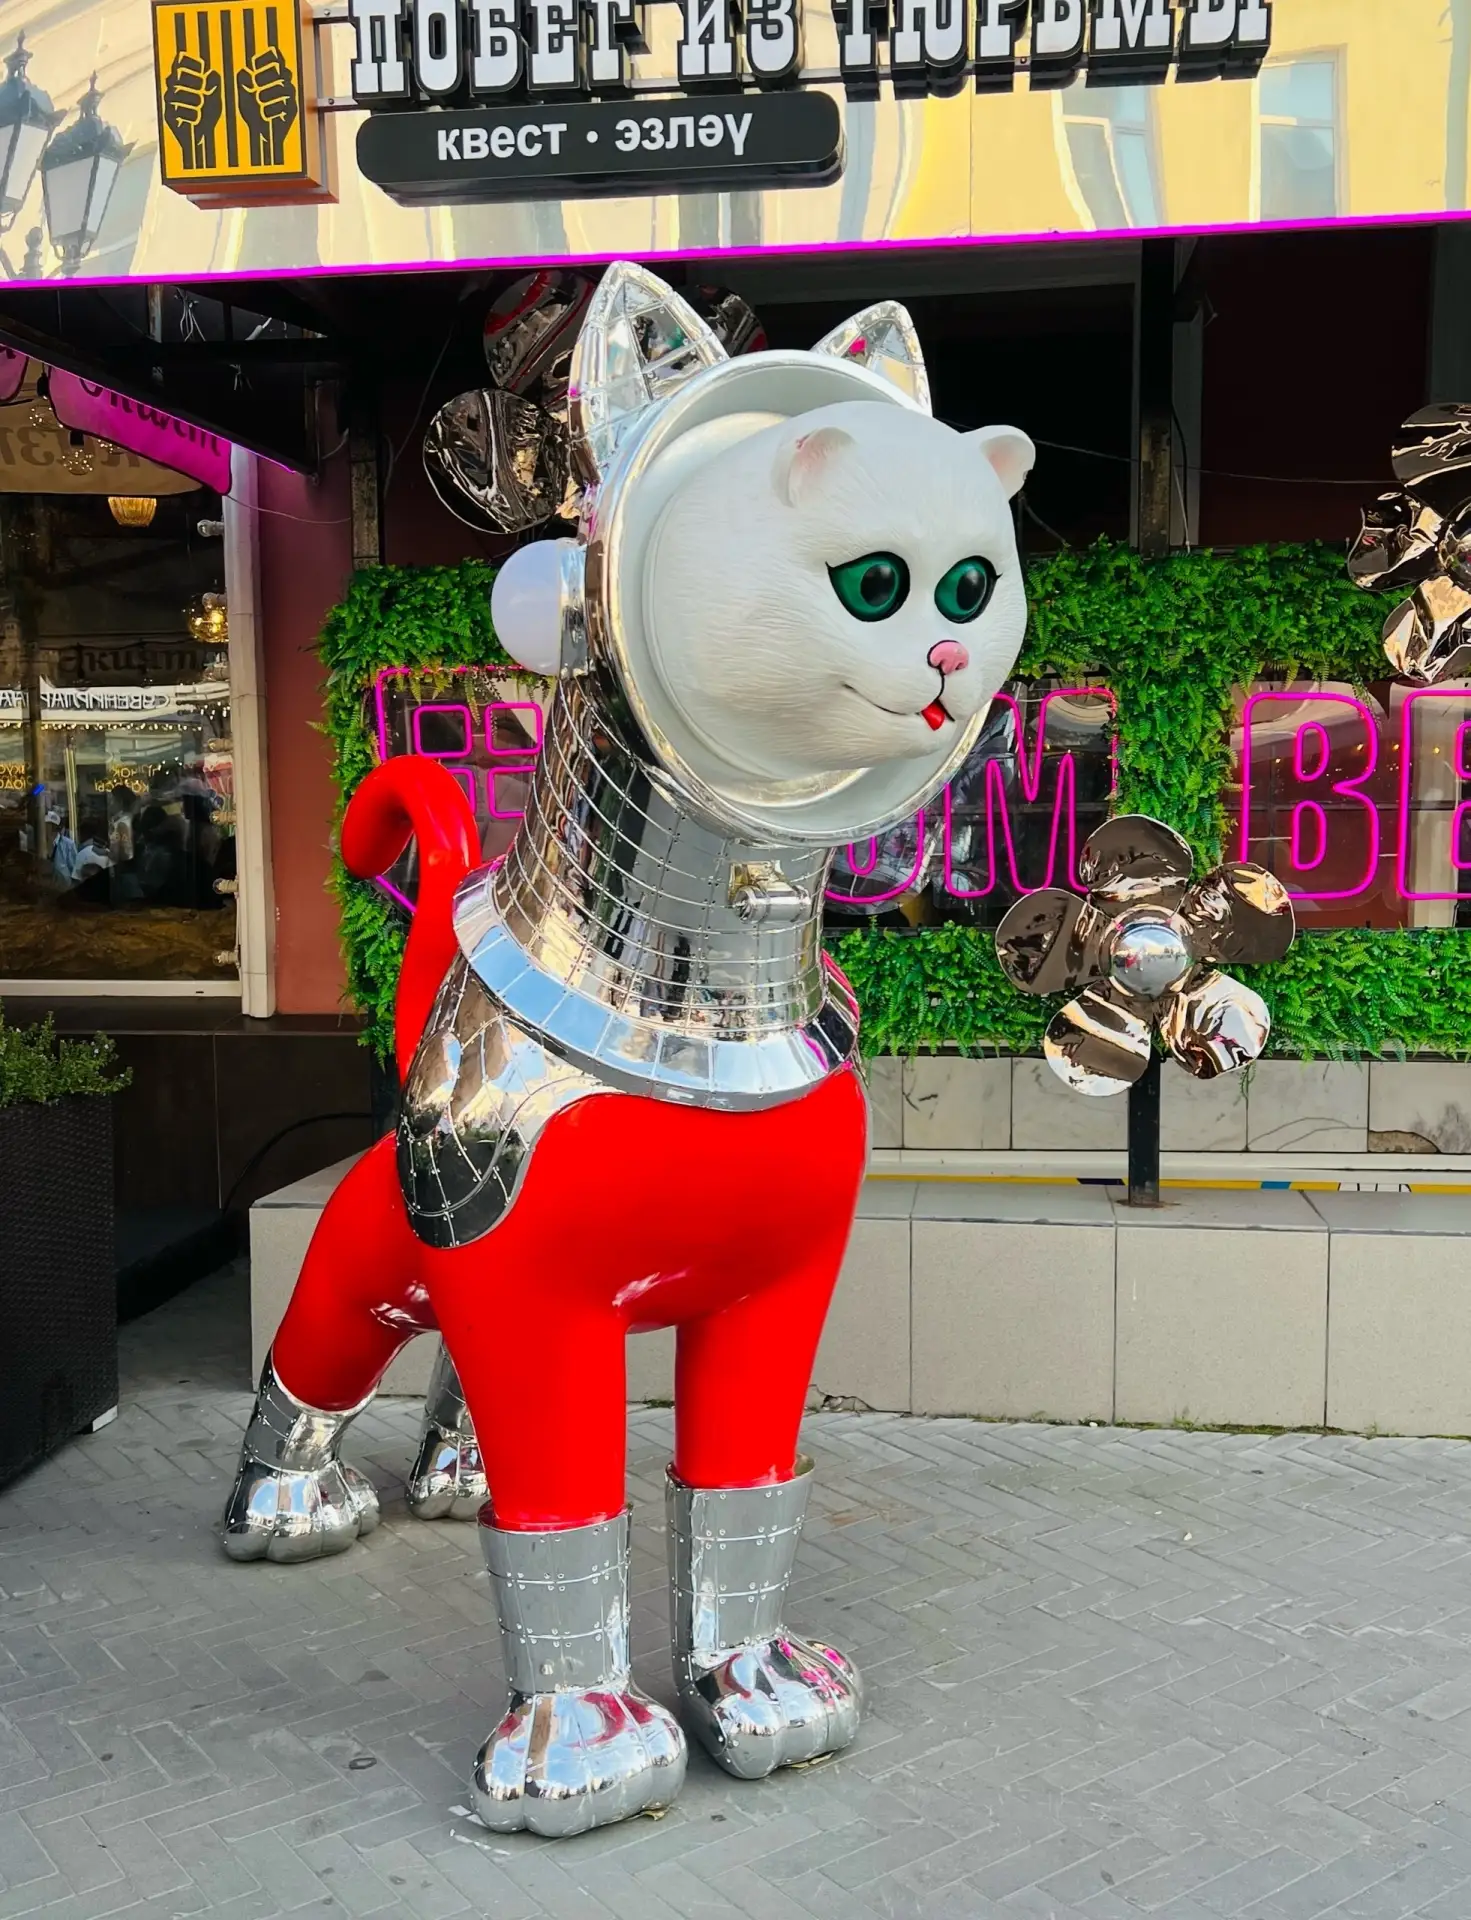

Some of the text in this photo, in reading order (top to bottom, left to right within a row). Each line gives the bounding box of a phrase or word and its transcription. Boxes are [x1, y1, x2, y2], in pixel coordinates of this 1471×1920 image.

[352, 0, 637, 98] ПОБЕГ
[678, 0, 798, 81] ИЗ
[437, 112, 753, 161] квест эзләү
